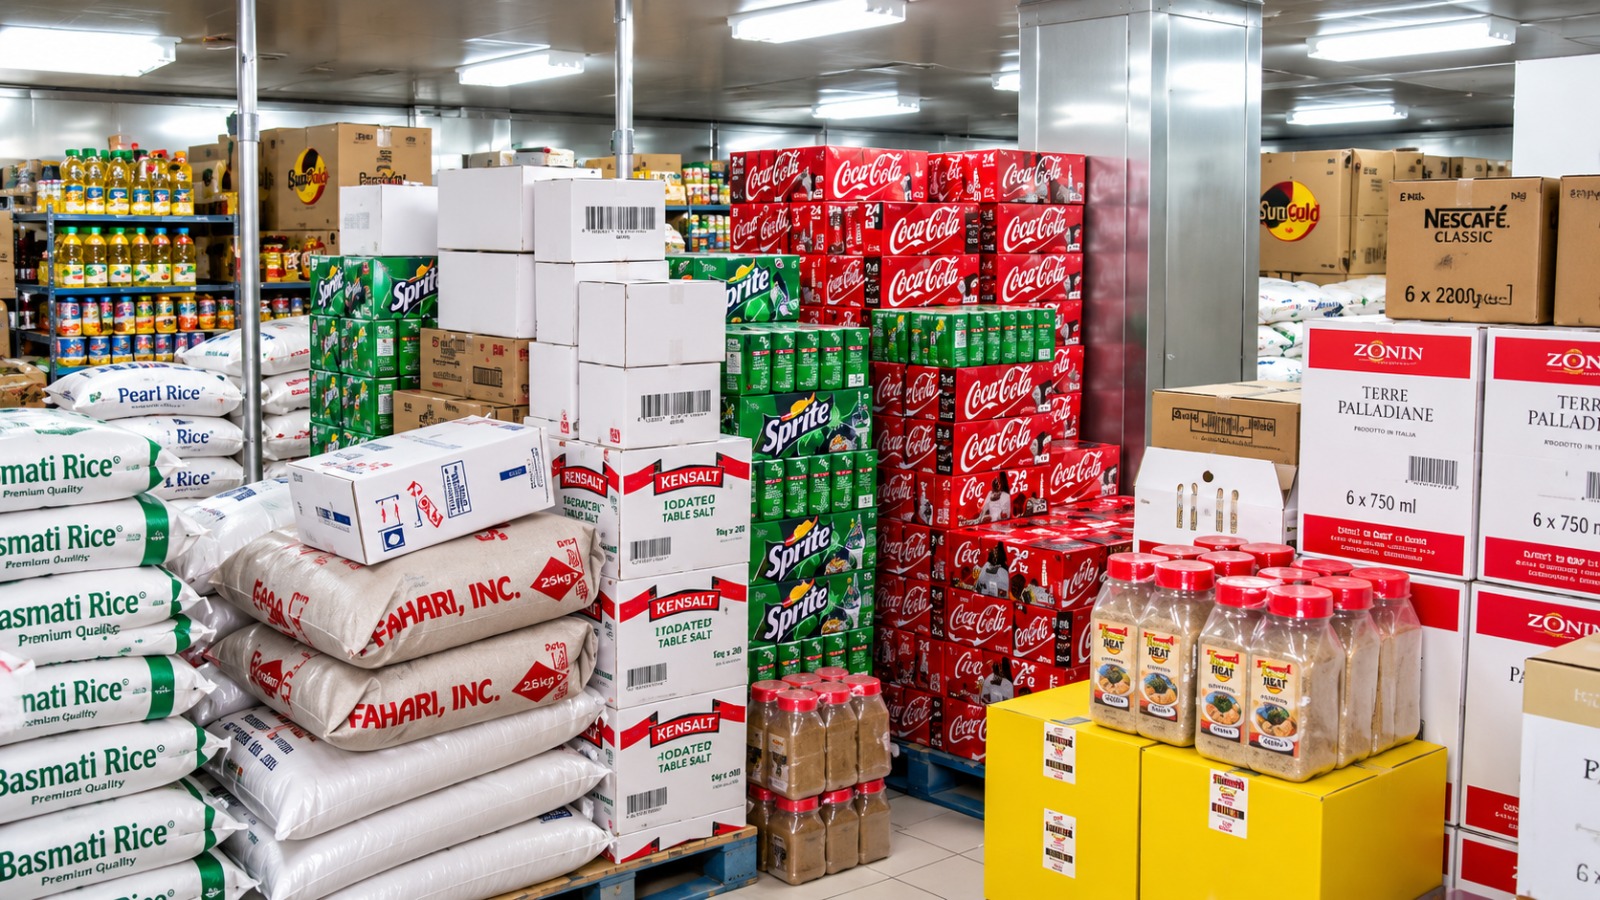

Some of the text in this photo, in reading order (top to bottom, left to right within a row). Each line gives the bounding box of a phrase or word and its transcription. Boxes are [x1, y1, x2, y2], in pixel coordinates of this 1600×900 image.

[833, 152, 904, 199] Coca-Cola
[889, 206, 962, 255] Coca-Cola
[1002, 206, 1068, 254] Coca-Cola
[1434, 230, 1493, 244] CLASSIC
[390, 266, 439, 313] Sprit
[726, 267, 770, 308] prite
[888, 256, 961, 307] Coca-Cola
[1002, 256, 1068, 303] Coca-Cola
[1405, 285, 1415, 303] 6
[1420, 291, 1431, 303] x
[1353, 342, 1425, 362] ZONIN
[1545, 351, 1600, 371] ZON
[117, 384, 200, 404] Pearl Rice
[964, 364, 1034, 421] Coca-Cola
[1362, 385, 1409, 403] TERRE
[1557, 394, 1600, 412] TERR
[1337, 400, 1434, 423] PALLADIANE
[176, 428, 210, 445] Rice
[761, 398, 832, 456] Sprite
[959, 417, 1033, 473] Coca-Cola
[0, 453, 113, 486] mati Rice
[176, 470, 210, 488] Rice
[660, 469, 721, 490] KENSALT
[47, 485, 84, 497] Quality
[1346, 490, 1417, 514] 6 x 750 ml
[662, 506, 716, 523] TABLE SALT
[1533, 511, 1542, 528] 6
[1546, 517, 1556, 530] x
[1560, 515, 1588, 534] 750
[0, 523, 117, 557] smati Rice
[765, 526, 830, 583] Sprite
[0, 590, 140, 631] asmati Rice
[371, 575, 521, 649] FAHARI, INC.
[655, 595, 716, 615] KENSALT
[763, 586, 829, 644] Sprite
[657, 629, 714, 649] TABLE SALT
[73, 678, 123, 707] Rice
[347, 677, 501, 731] FAHARI, INC.
[656, 716, 716, 743] KENSALT
[0, 745, 157, 798] Basmati Rice
[658, 754, 713, 774] TABLE SALT
[0, 821, 168, 883] Basmati Rice
[1577, 863, 1589, 883] 6
